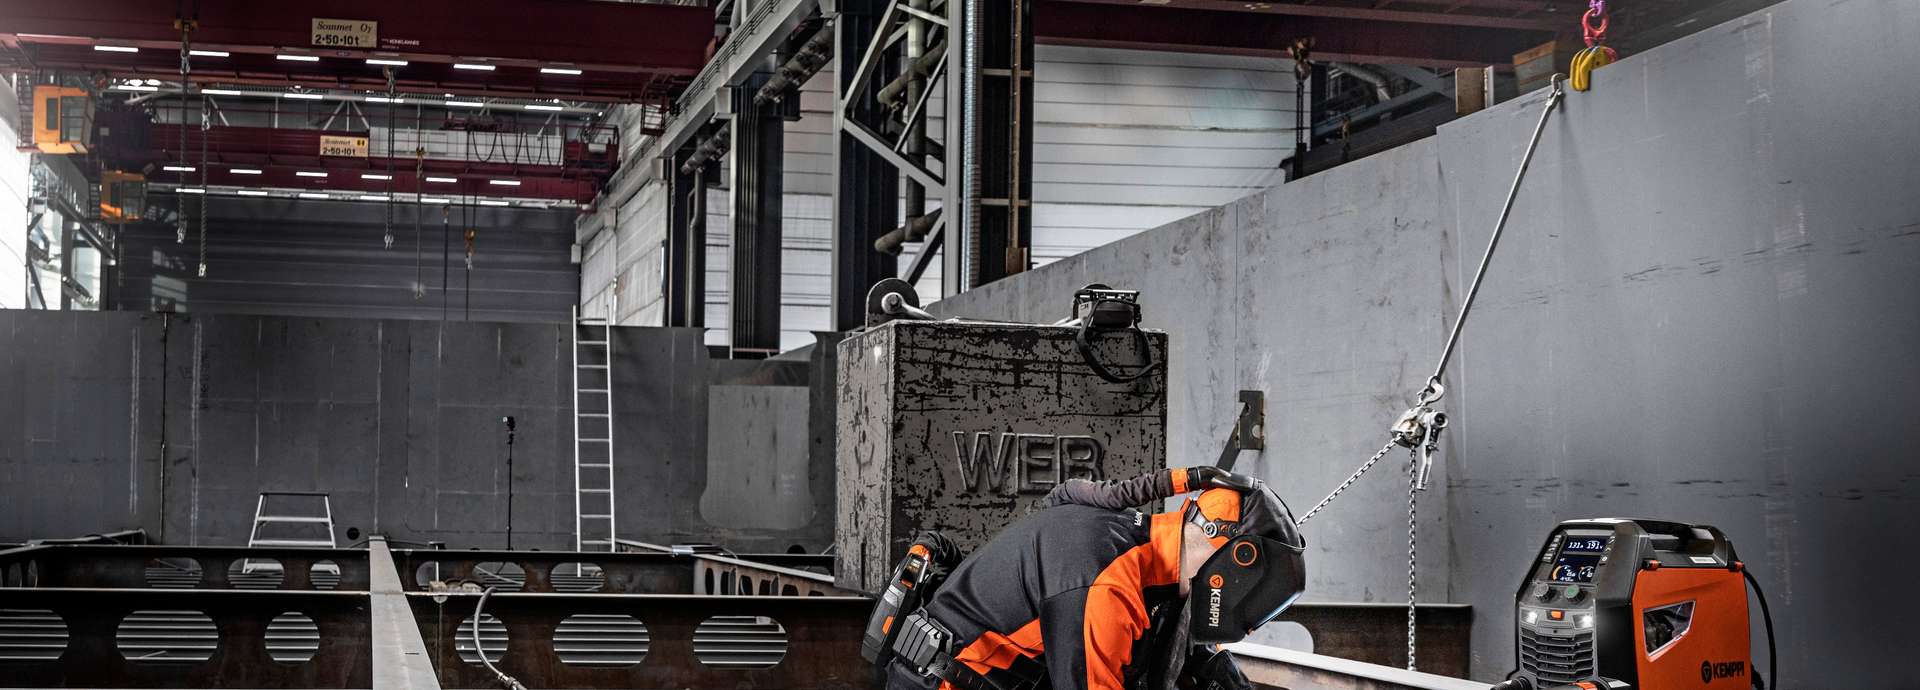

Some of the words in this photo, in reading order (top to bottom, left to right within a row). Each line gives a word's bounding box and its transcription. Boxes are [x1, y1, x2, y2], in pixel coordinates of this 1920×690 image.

[360, 23, 373, 33] Oy
[1208, 588, 1221, 627] KEMPPI
[1712, 660, 1745, 679] KEMPPI
